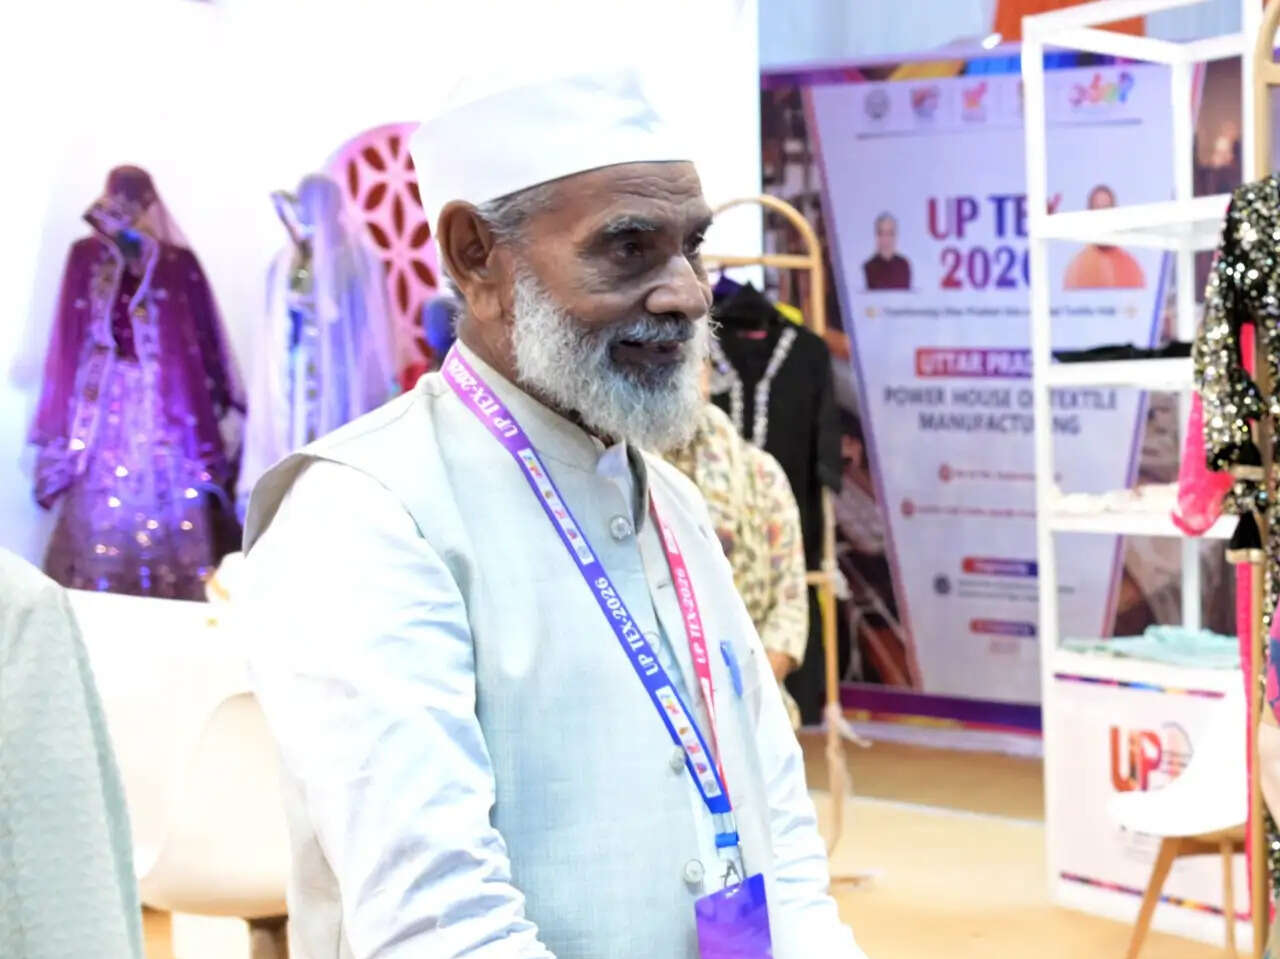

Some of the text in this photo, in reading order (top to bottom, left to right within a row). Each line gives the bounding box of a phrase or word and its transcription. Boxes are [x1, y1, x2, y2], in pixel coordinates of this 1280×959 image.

[928, 193, 1062, 239] UP TE
[951, 388, 1010, 409] HOUSE
[493, 414, 519, 439] UP
[595, 576, 660, 677] UP TEX-2026
[1109, 724, 1163, 793] UP
